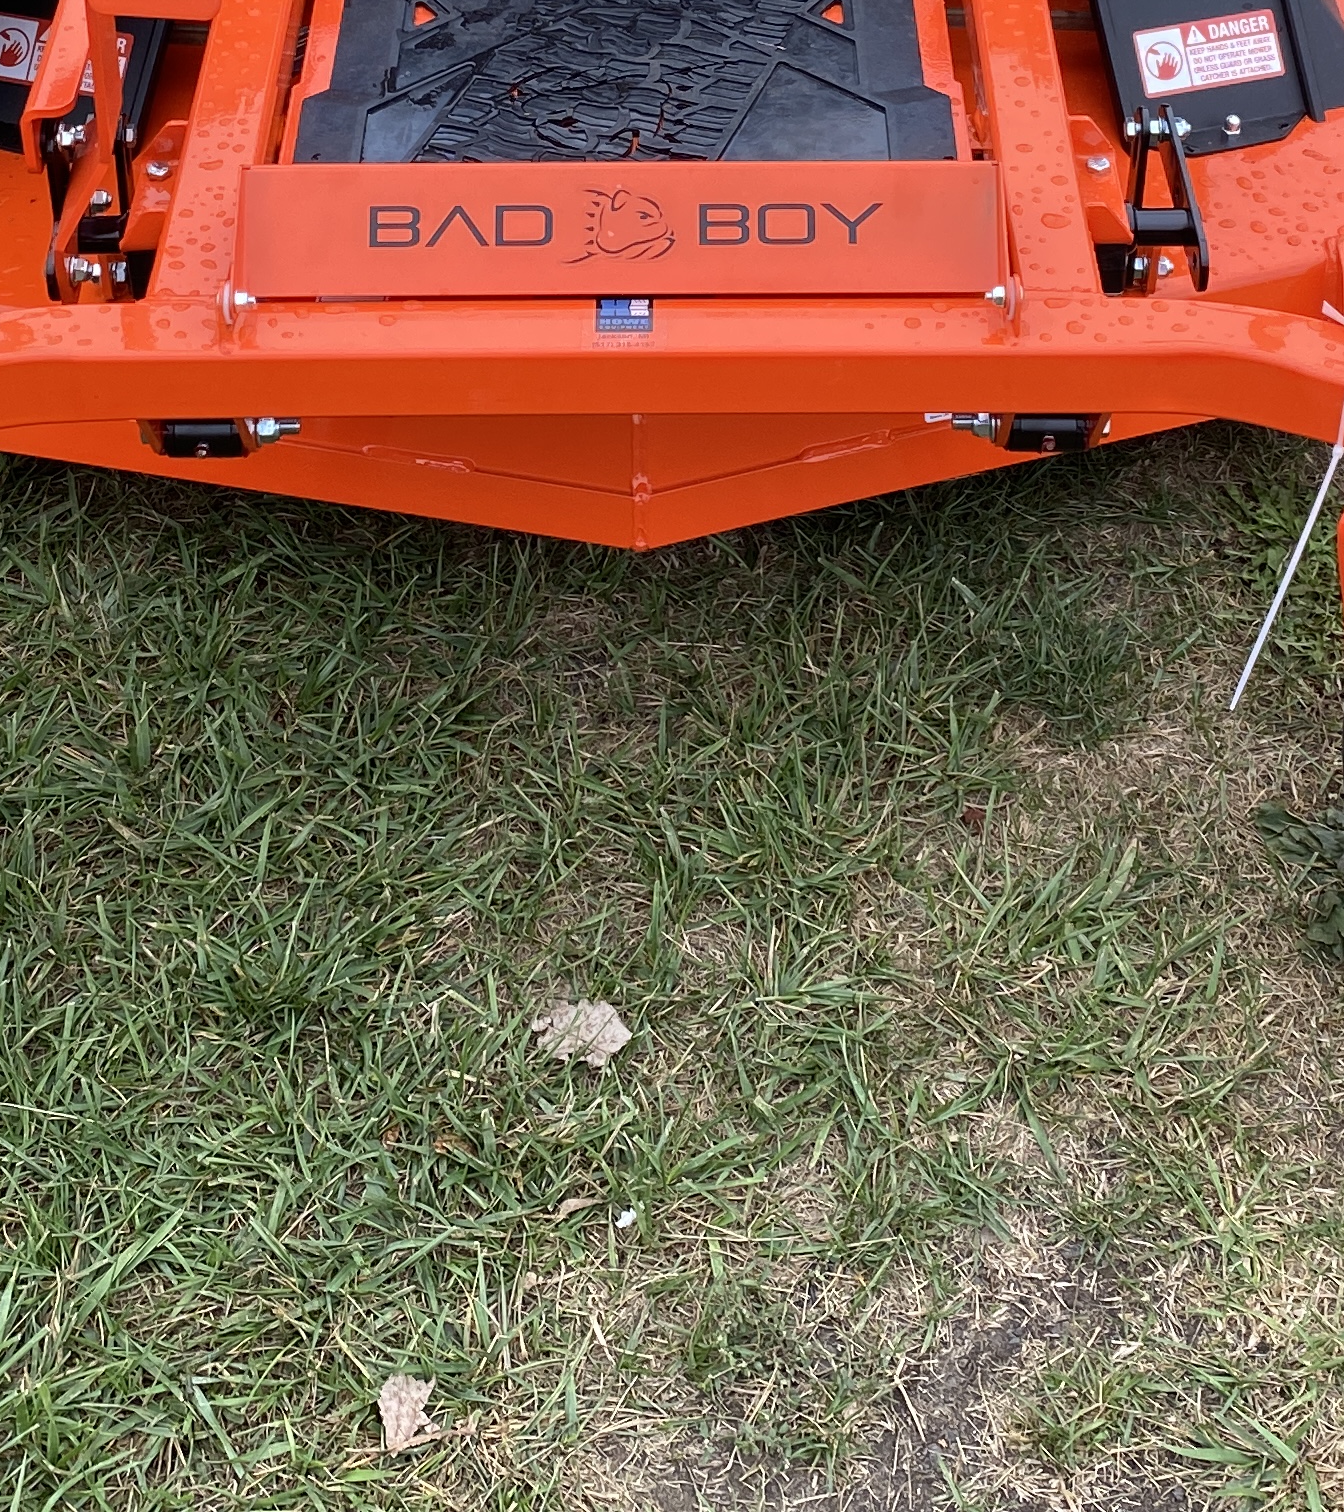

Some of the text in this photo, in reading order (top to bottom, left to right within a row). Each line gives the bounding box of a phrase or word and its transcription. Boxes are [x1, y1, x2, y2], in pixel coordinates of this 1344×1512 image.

[1208, 16, 1269, 40] DANGER
[369, 202, 884, 248] BAD BOY
